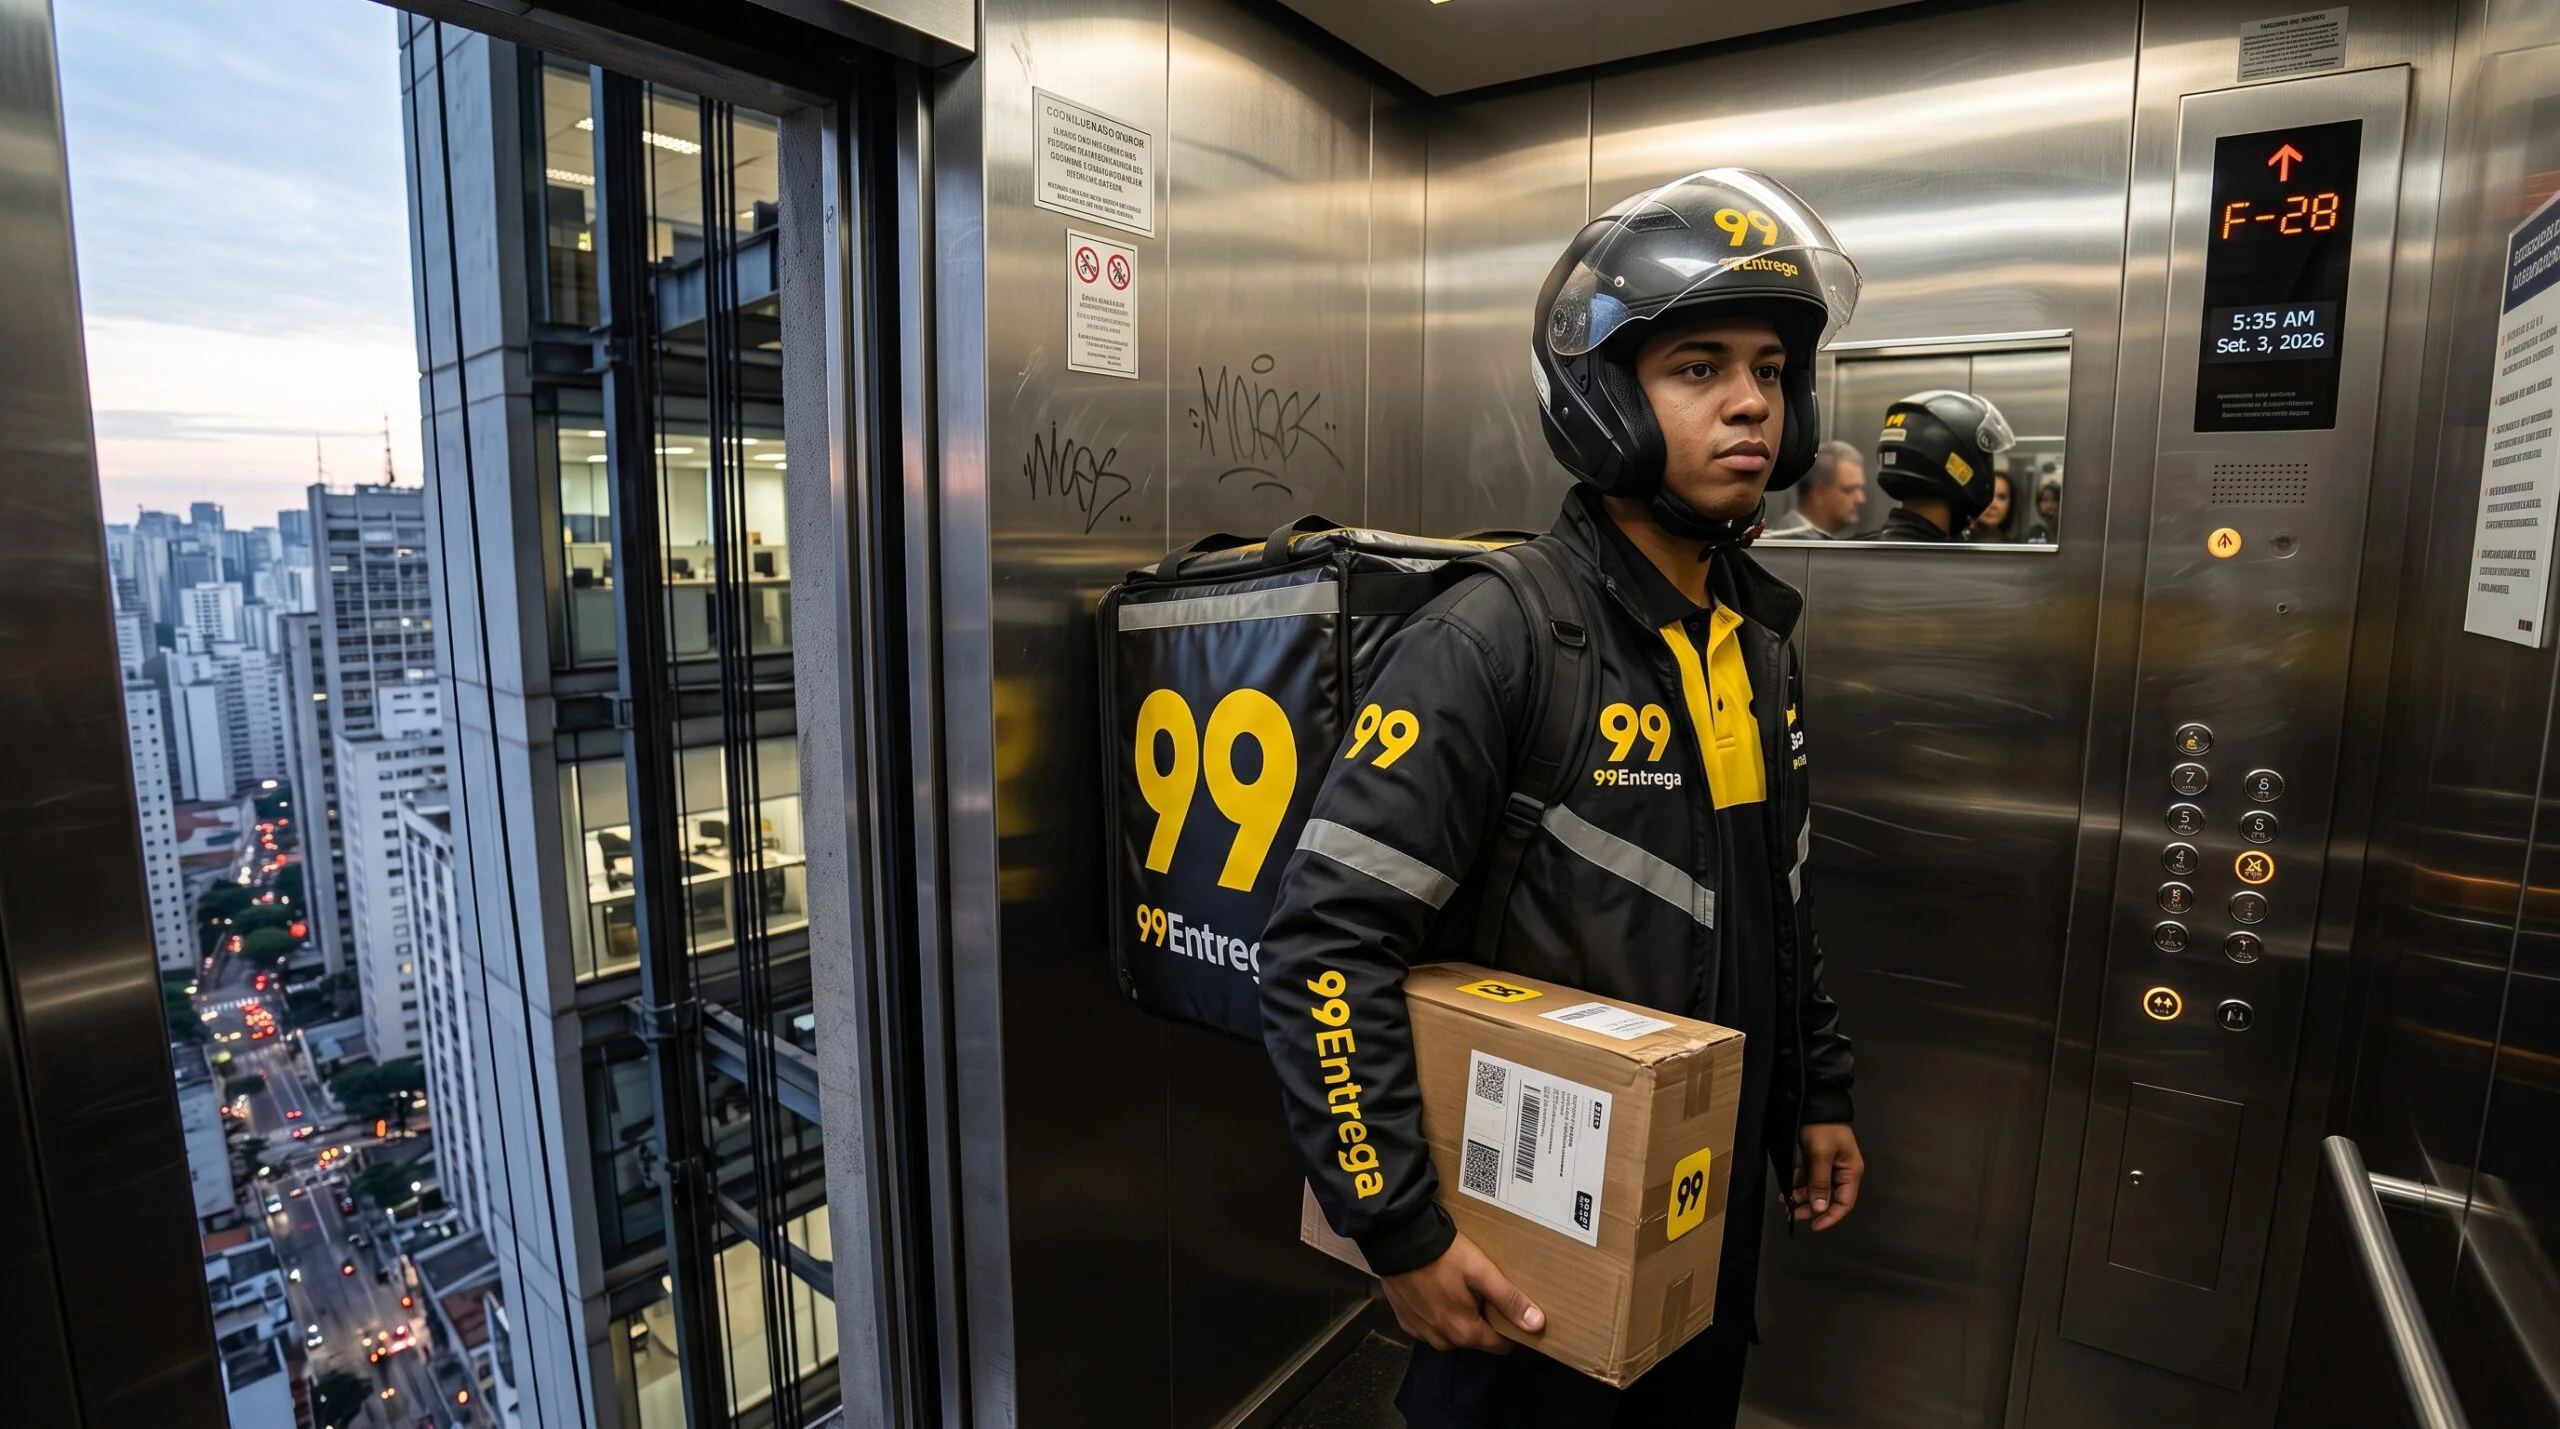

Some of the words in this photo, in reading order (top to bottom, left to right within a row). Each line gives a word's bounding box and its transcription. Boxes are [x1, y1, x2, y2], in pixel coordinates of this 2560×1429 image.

[1713, 208, 1778, 246] 99
[2223, 192, 2338, 239] F-28
[2216, 338, 2251, 354] Set.
[2256, 336, 2273, 354] 3,
[2280, 333, 2325, 350] 2026
[2232, 312, 2277, 331] 5:35
[2283, 310, 2315, 328] AM
[1344, 703, 1420, 769] 99
[1599, 702, 1672, 762] 99
[1135, 688, 1298, 893] 99
[1593, 768, 1682, 790] 99Entrega
[2186, 771, 2196, 784] 7
[1306, 970, 1384, 1199] 99Entrega
[1677, 1170, 1704, 1218] 99
